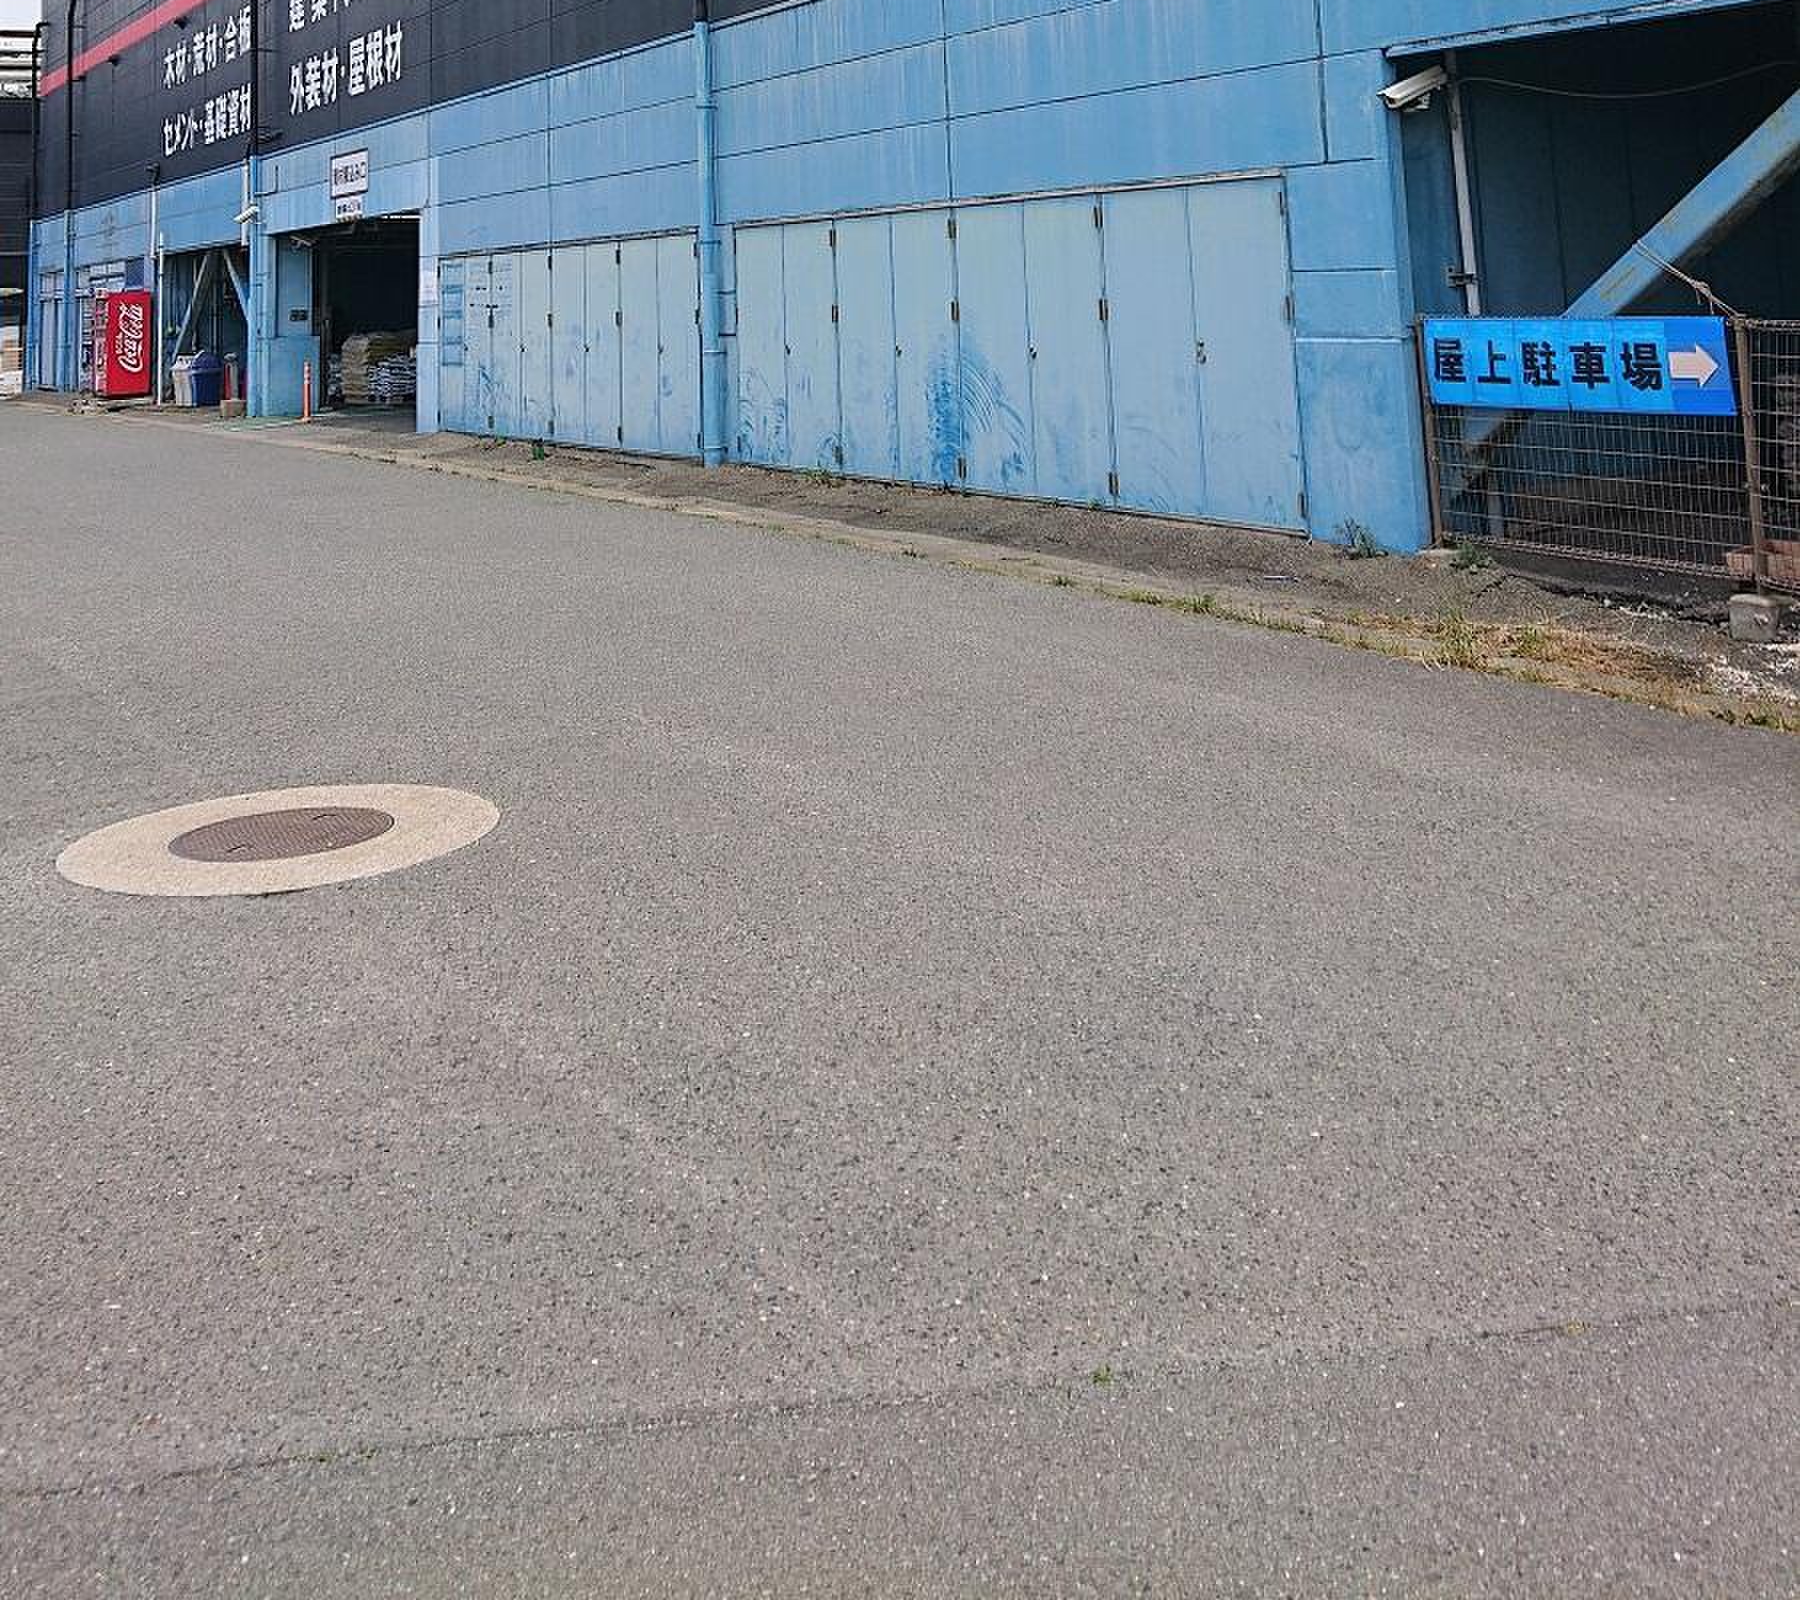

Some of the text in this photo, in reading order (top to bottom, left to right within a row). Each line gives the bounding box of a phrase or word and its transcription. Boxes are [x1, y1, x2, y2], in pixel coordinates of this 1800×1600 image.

[290, 20, 401, 114] 外装材・屋根材
[1434, 337, 1663, 390] 屋上駐車場
